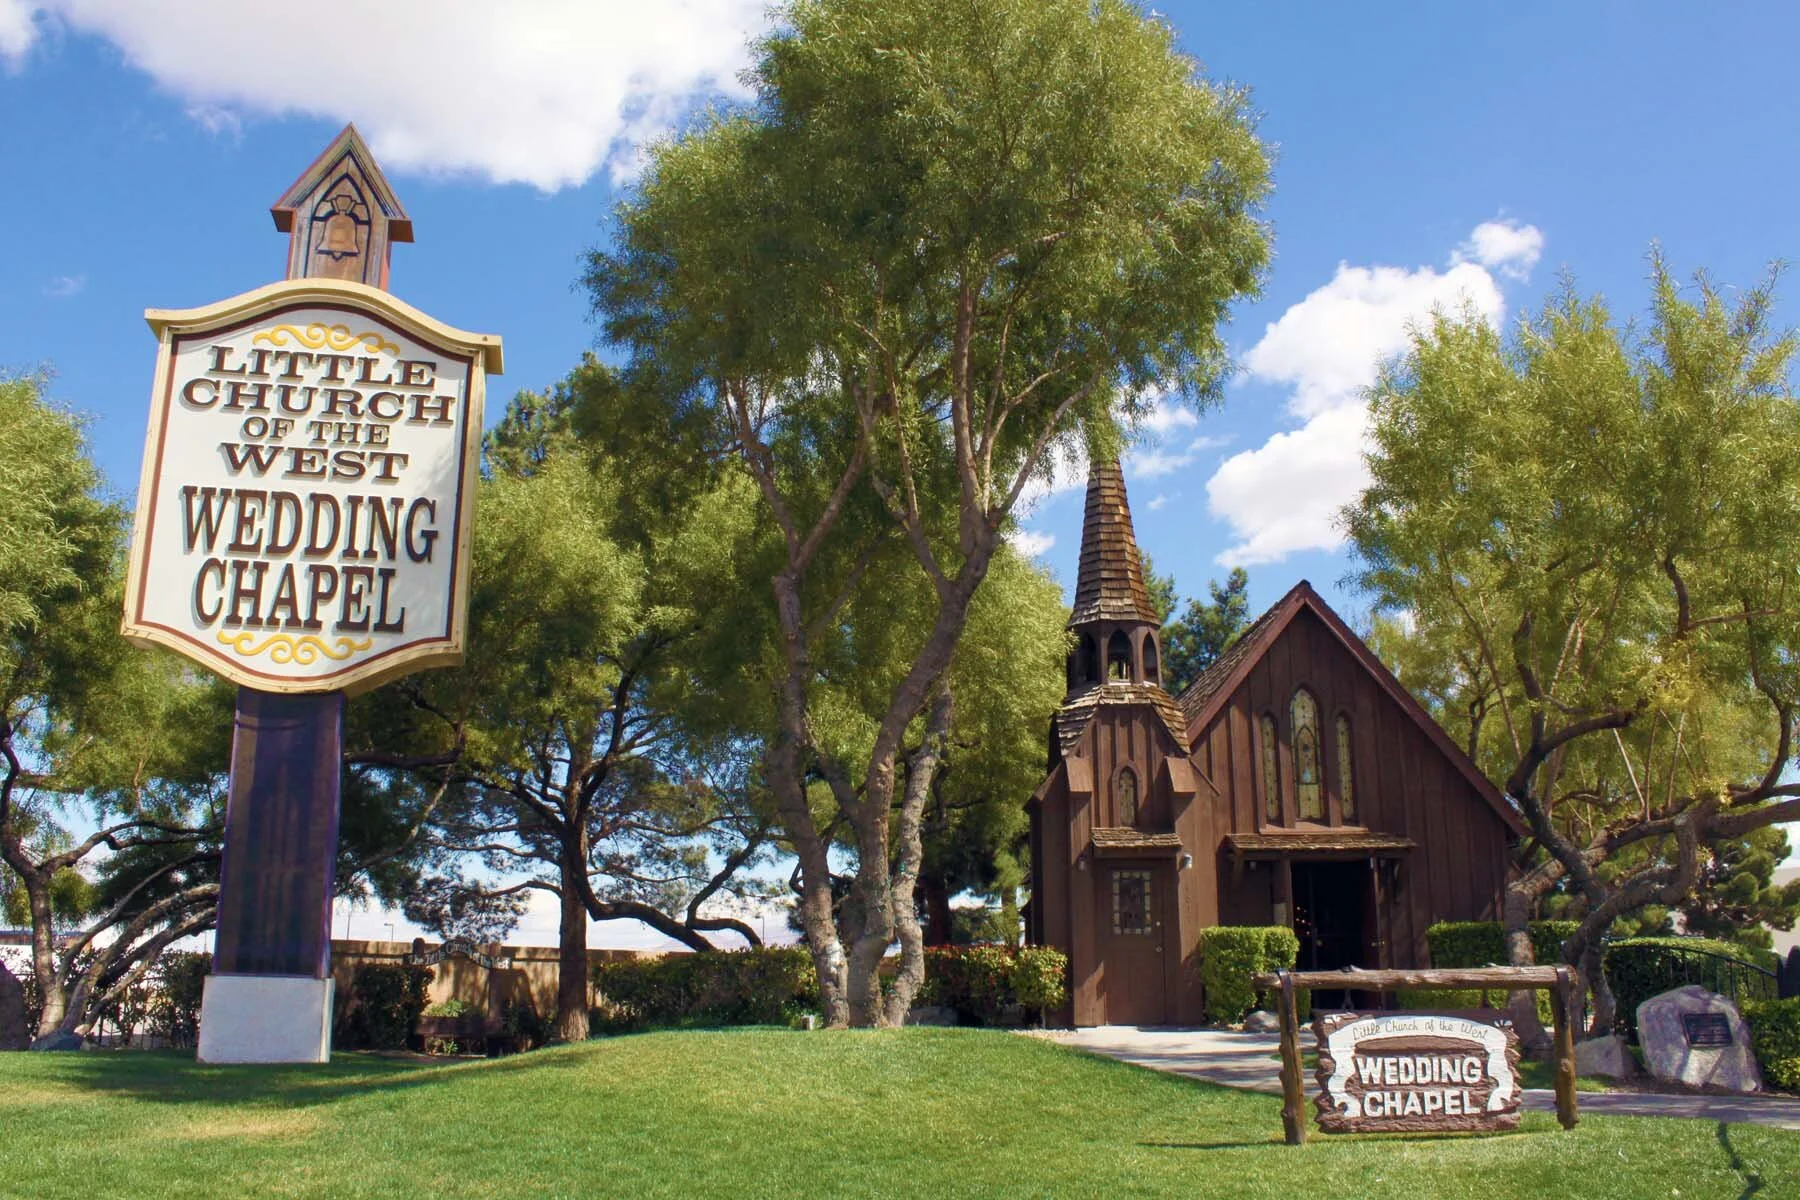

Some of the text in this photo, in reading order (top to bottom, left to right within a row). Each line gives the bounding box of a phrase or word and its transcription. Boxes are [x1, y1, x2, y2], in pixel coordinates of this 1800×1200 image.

[208, 345, 437, 389] LITTLE
[182, 378, 455, 424] CHURCH
[243, 416, 390, 446] OF THE
[220, 442, 409, 480] WEST
[181, 485, 438, 562] WEDDING
[195, 557, 405, 633] CHAPEL
[1352, 1019, 1488, 1041] Little Church of the West
[1356, 1056, 1482, 1084] WEDDING
[1363, 1090, 1481, 1117] CHAPEL
